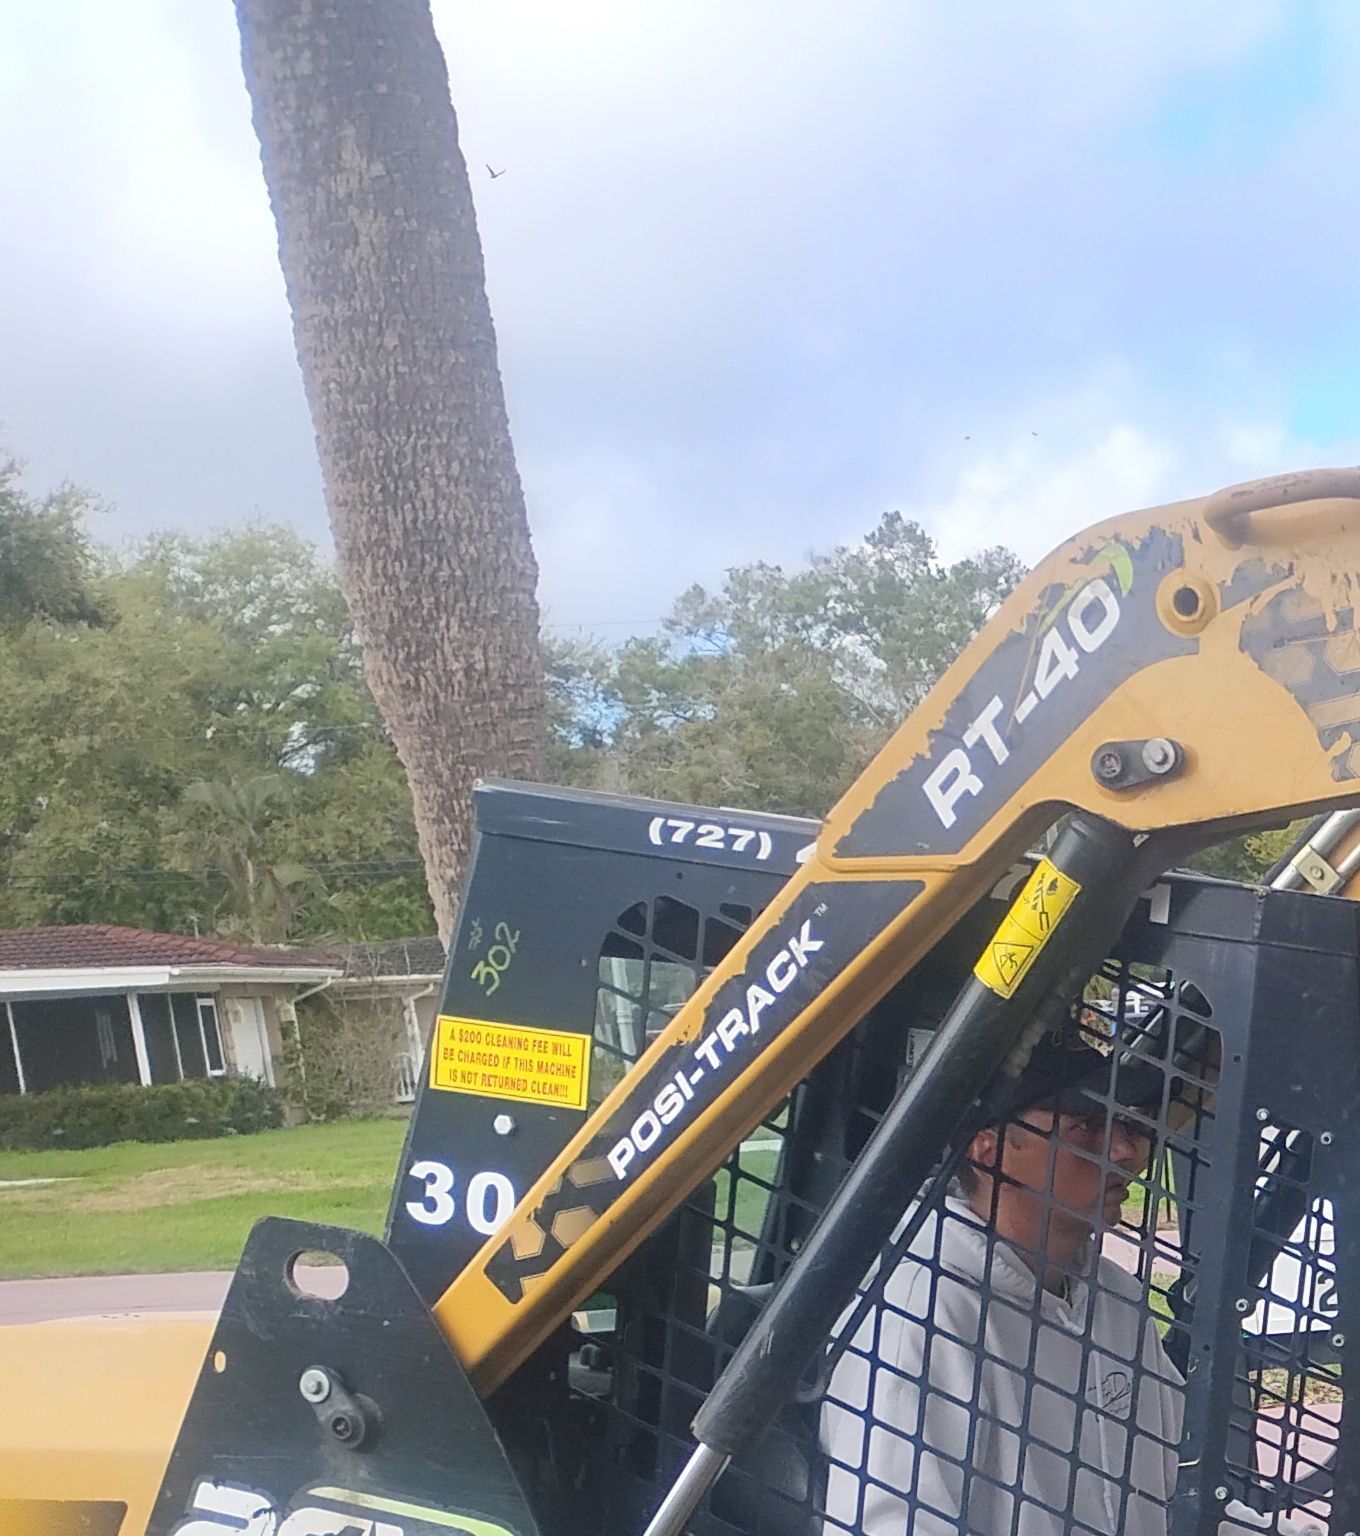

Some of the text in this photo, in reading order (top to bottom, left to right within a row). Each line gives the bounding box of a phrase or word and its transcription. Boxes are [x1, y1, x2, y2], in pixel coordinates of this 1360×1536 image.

[922, 578, 1122, 829] RT-40
[648, 817, 772, 860] (727)
[471, 922, 520, 996] 302
[443, 1047, 577, 1079] BE CHARGED IF THIS MACHINE
[449, 1028, 572, 1057] A $200 CLEANING FEE WILL
[607, 919, 824, 1179] POSI-TRACK
[449, 1068, 458, 1082] IS
[460, 1070, 478, 1085] NOT
[481, 1073, 528, 1092] RETURNED
